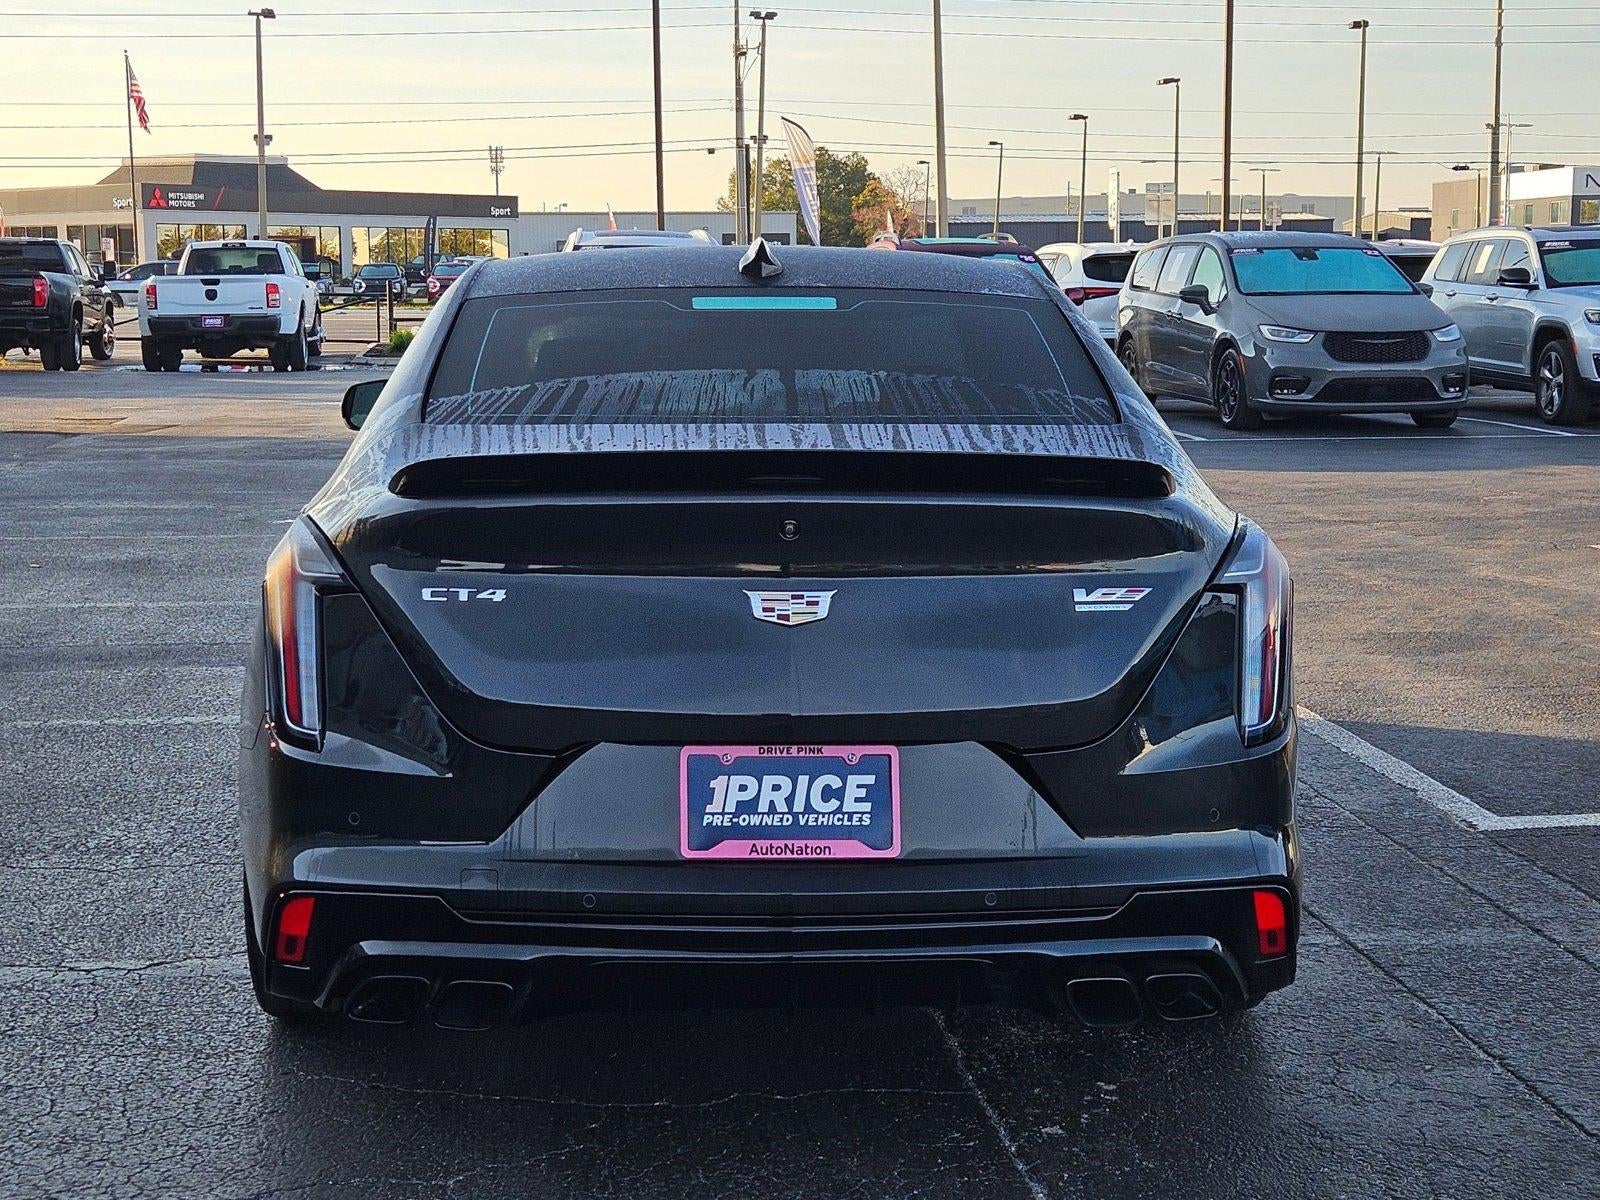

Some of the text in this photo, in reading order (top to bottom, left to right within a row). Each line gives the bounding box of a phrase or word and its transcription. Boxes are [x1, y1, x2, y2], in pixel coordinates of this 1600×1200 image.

[168, 192, 205, 200] MITSUBISHI
[168, 200, 196, 208] MOTORS
[490, 206, 511, 217] Sport
[421, 587, 508, 602] CT4
[758, 746, 824, 756] DRIVE PINK
[704, 773, 877, 814] 1PRICE
[702, 813, 872, 827] PRE-OWNED VEHICLES
[748, 842, 833, 856] AutoNation
